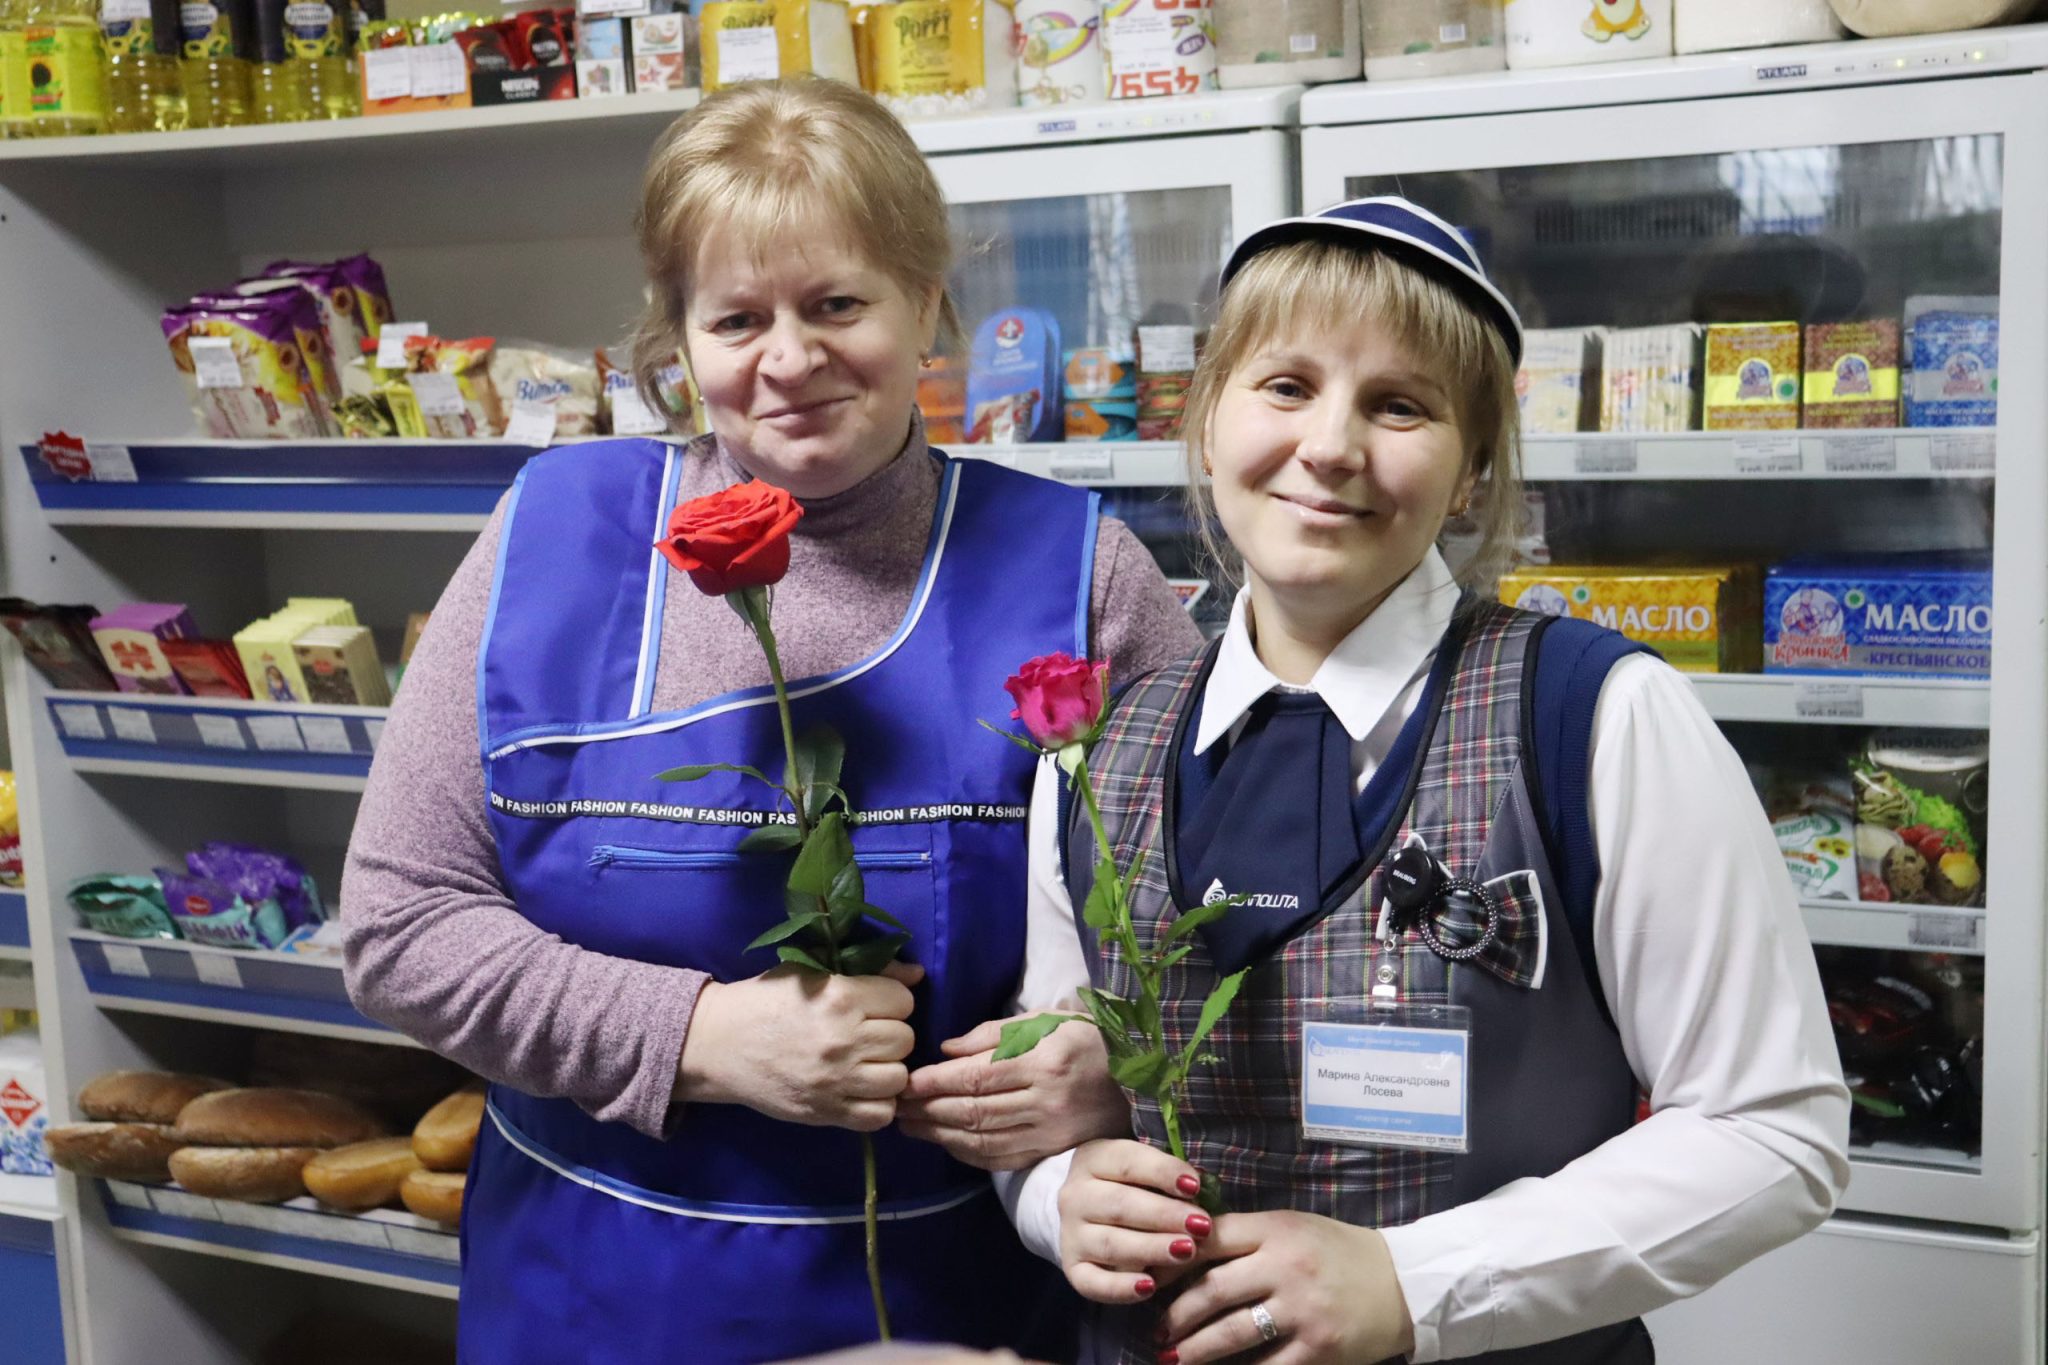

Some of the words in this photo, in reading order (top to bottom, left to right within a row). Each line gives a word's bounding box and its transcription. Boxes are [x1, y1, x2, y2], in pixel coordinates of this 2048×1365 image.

[1592, 604, 1711, 632] МАСЛО
[1864, 603, 1992, 634] МАСЛО
[506, 799, 567, 814] FASHION
[571, 800, 626, 813] FASHION
[630, 803, 693, 819] FASHION
[698, 809, 763, 824] FASHION
[910, 804, 973, 820] FASHION
[1317, 1068, 1361, 1081] Марина
[1363, 1072, 1450, 1088] Александровна
[1363, 1085, 1404, 1098] Лосева
